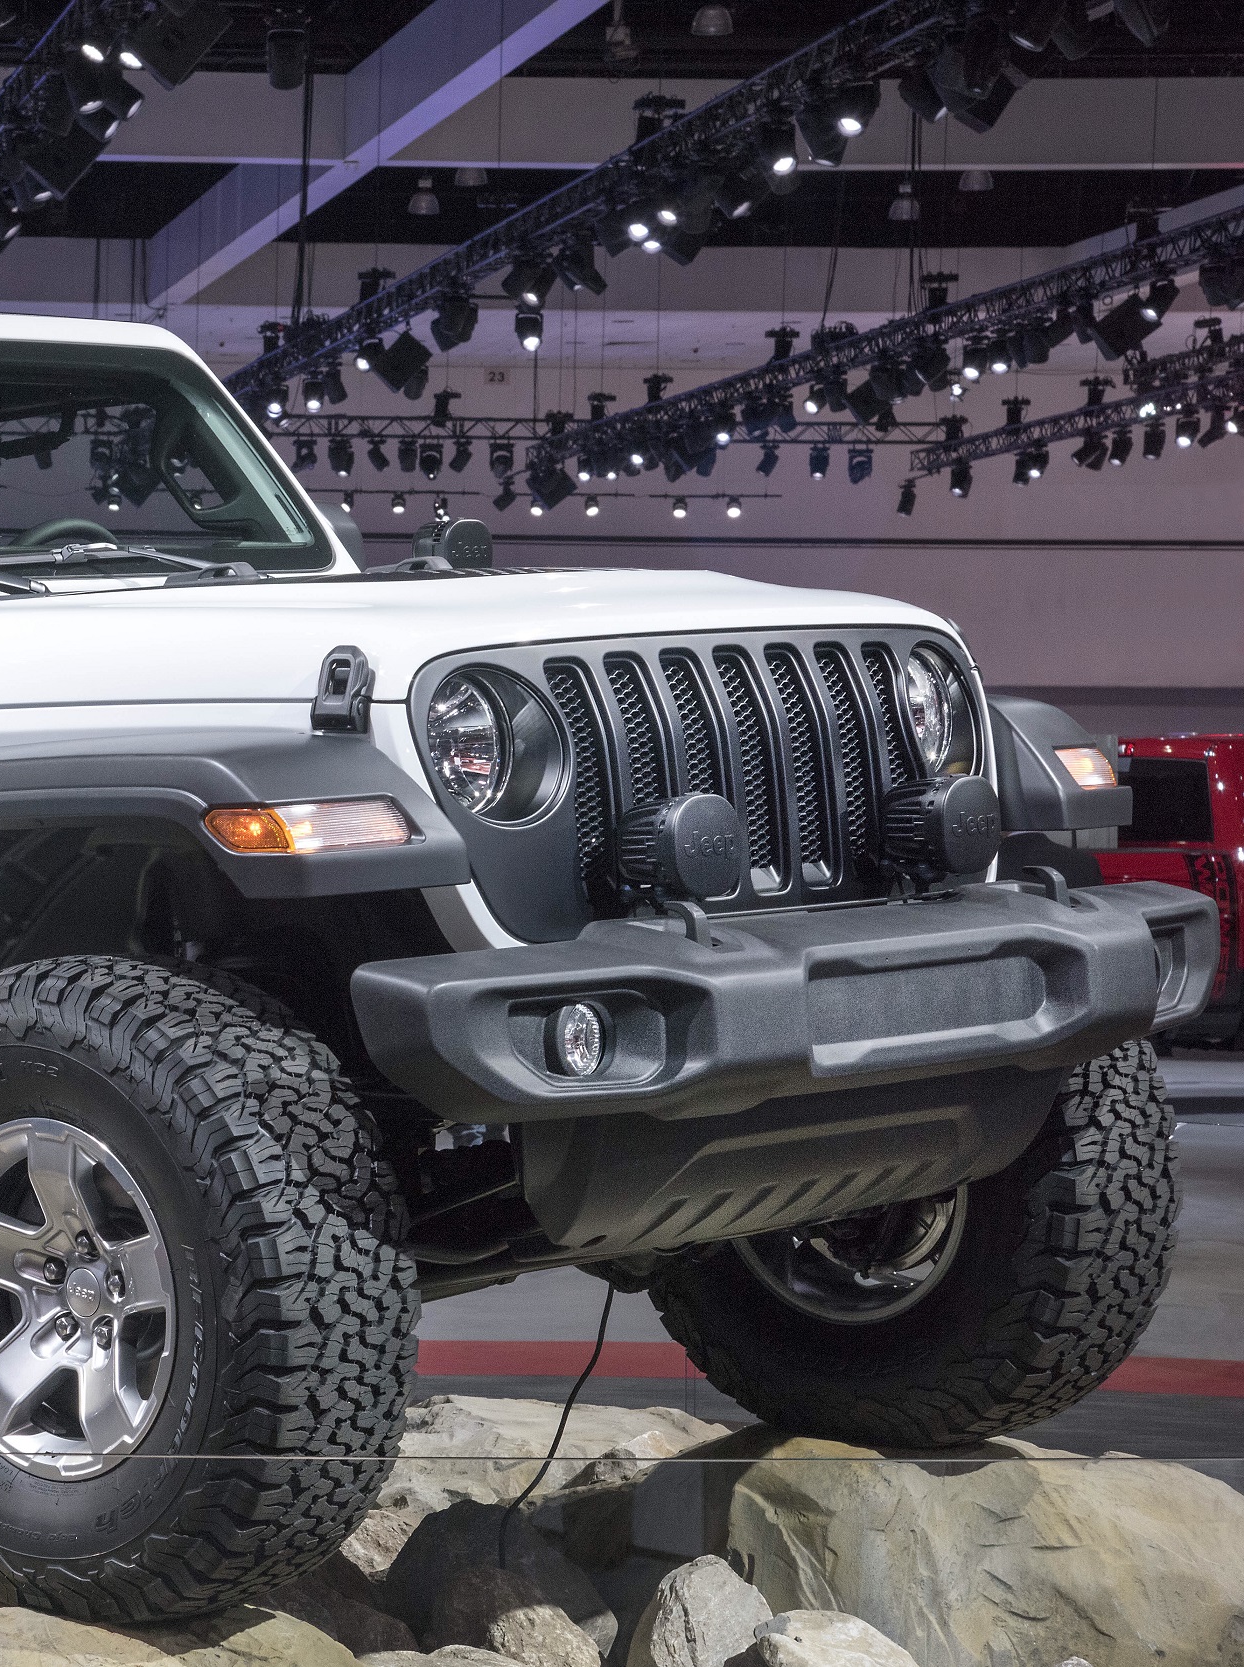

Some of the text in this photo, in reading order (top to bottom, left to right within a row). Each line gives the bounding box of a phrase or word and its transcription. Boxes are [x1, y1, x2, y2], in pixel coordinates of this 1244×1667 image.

[488, 371, 505, 382] 23
[952, 811, 996, 838] Jeep
[684, 831, 735, 859] Jeep
